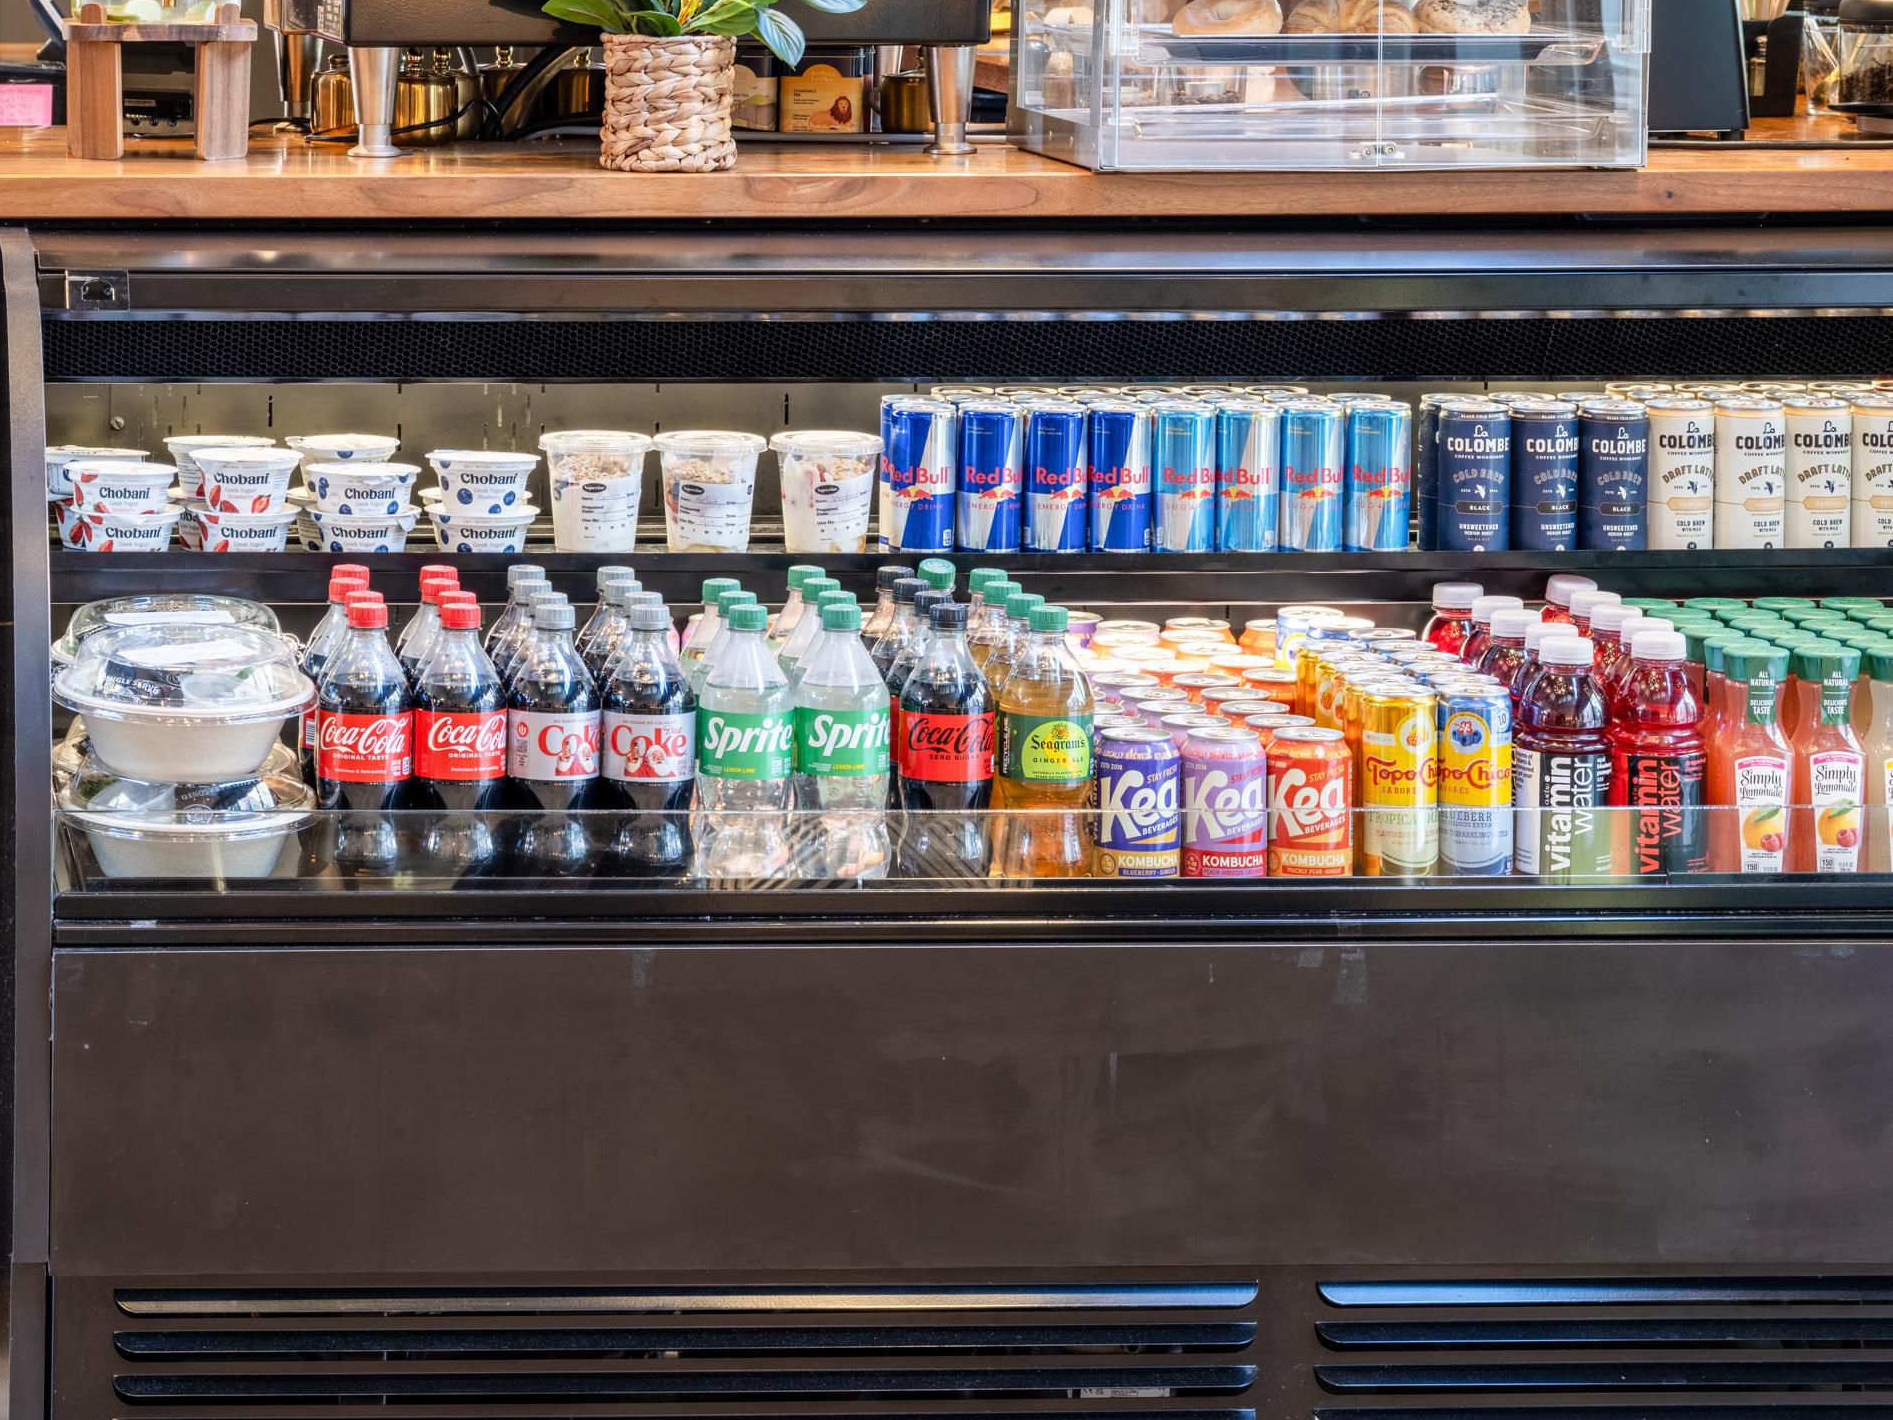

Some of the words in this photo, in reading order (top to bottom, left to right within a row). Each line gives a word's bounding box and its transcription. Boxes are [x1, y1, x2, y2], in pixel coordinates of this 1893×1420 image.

[1473, 424, 1489, 438] La
[1554, 424, 1569, 438] La
[1617, 427, 1629, 439] La
[1686, 421, 1700, 434] La
[1763, 421, 1775, 434] La
[1823, 420, 1837, 433] La
[1447, 437, 1510, 453] COLOMBE
[1526, 437, 1579, 453] COLOMB
[1592, 439, 1646, 455] COLOMBE
[1735, 435, 1785, 450] COLOMB
[1794, 433, 1851, 448] COLOMB
[1862, 432, 1893, 447] COLO
[214, 473, 270, 485] Chobani
[460, 473, 518, 485] Chobani
[916, 467, 948, 484] Bull
[966, 466, 1000, 484] Red
[1035, 467, 1070, 485] Red
[1088, 464, 1116, 484] Red
[1119, 467, 1149, 484] Bull
[1163, 467, 1198, 484] Red
[1236, 467, 1270, 485] Bull
[1285, 465, 1319, 484] Red
[1321, 467, 1344, 483] Bul
[1353, 465, 1387, 484] Red
[1452, 468, 1479, 484] COLD
[1534, 468, 1560, 485] COLD
[1597, 471, 1621, 486] COLD
[1662, 464, 1692, 484] DRAFT
[1738, 465, 1769, 485] DRAFT
[1797, 463, 1829, 483] DRAFT
[1865, 463, 1893, 482] DRAFT
[99, 487, 151, 499] Chobani
[344, 487, 396, 500] Chobani
[106, 526, 162, 539] Chobani
[220, 526, 278, 539] Chobani
[331, 526, 389, 539] Chobani
[460, 526, 518, 539] Chobani
[1459, 523, 1499, 531] UNSWEETENED
[1540, 523, 1575, 531] UNSWEETENED
[1603, 524, 1638, 532] UNSWEETENED
[106, 675, 131, 685] INGLE
[1750, 678, 1776, 687] NATURAL
[1823, 678, 1849, 687] NATURAL
[1753, 706, 1771, 715] TASTE
[1827, 706, 1845, 715] TASTE
[1497, 713, 1507, 725] 10
[320, 715, 409, 755] Coca-Cola
[611, 724, 688, 758] Coke
[704, 716, 792, 759] Sprite
[908, 717, 994, 755] Coca-Cola
[1030, 734, 1086, 753] Seagram's
[1111, 762, 1123, 771] 2018
[1147, 770, 1163, 784] STAY
[1163, 764, 1178, 777] FRESH
[1195, 762, 1207, 771] 2018
[1309, 771, 1326, 783] STAY
[1327, 764, 1345, 777] FRESH
[1366, 756, 1416, 786] Topo
[1419, 757, 1438, 788] Chi
[1815, 764, 1857, 784] Simply
[1466, 759, 1511, 790] Chico
[1740, 769, 1782, 789] Simply
[1739, 786, 1783, 800] Lemonade
[1814, 781, 1857, 796] Lemonade
[1268, 768, 1346, 840] Kea
[1571, 758, 1593, 836] water
[1658, 760, 1682, 838] water
[1100, 770, 1178, 843] Kea
[1186, 770, 1264, 843] Kea
[1369, 810, 1418, 825] TROPICA
[1440, 811, 1493, 822] BLUEBERR
[1544, 757, 1572, 872] vitamin
[1632, 759, 1660, 874] vitamin
[1142, 815, 1178, 836] BEVERAGES
[1226, 815, 1264, 836] BEVERAGES
[1304, 815, 1346, 835] BEVERAGES
[1118, 855, 1178, 867] KOMBUCHA
[1202, 855, 1264, 867] KOMBUCHA
[1282, 853, 1346, 866] KOMBUCHA
[1746, 863, 1758, 871] 150
[1822, 859, 1834, 867] 150
[1287, 867, 1308, 875] PRICKLY
